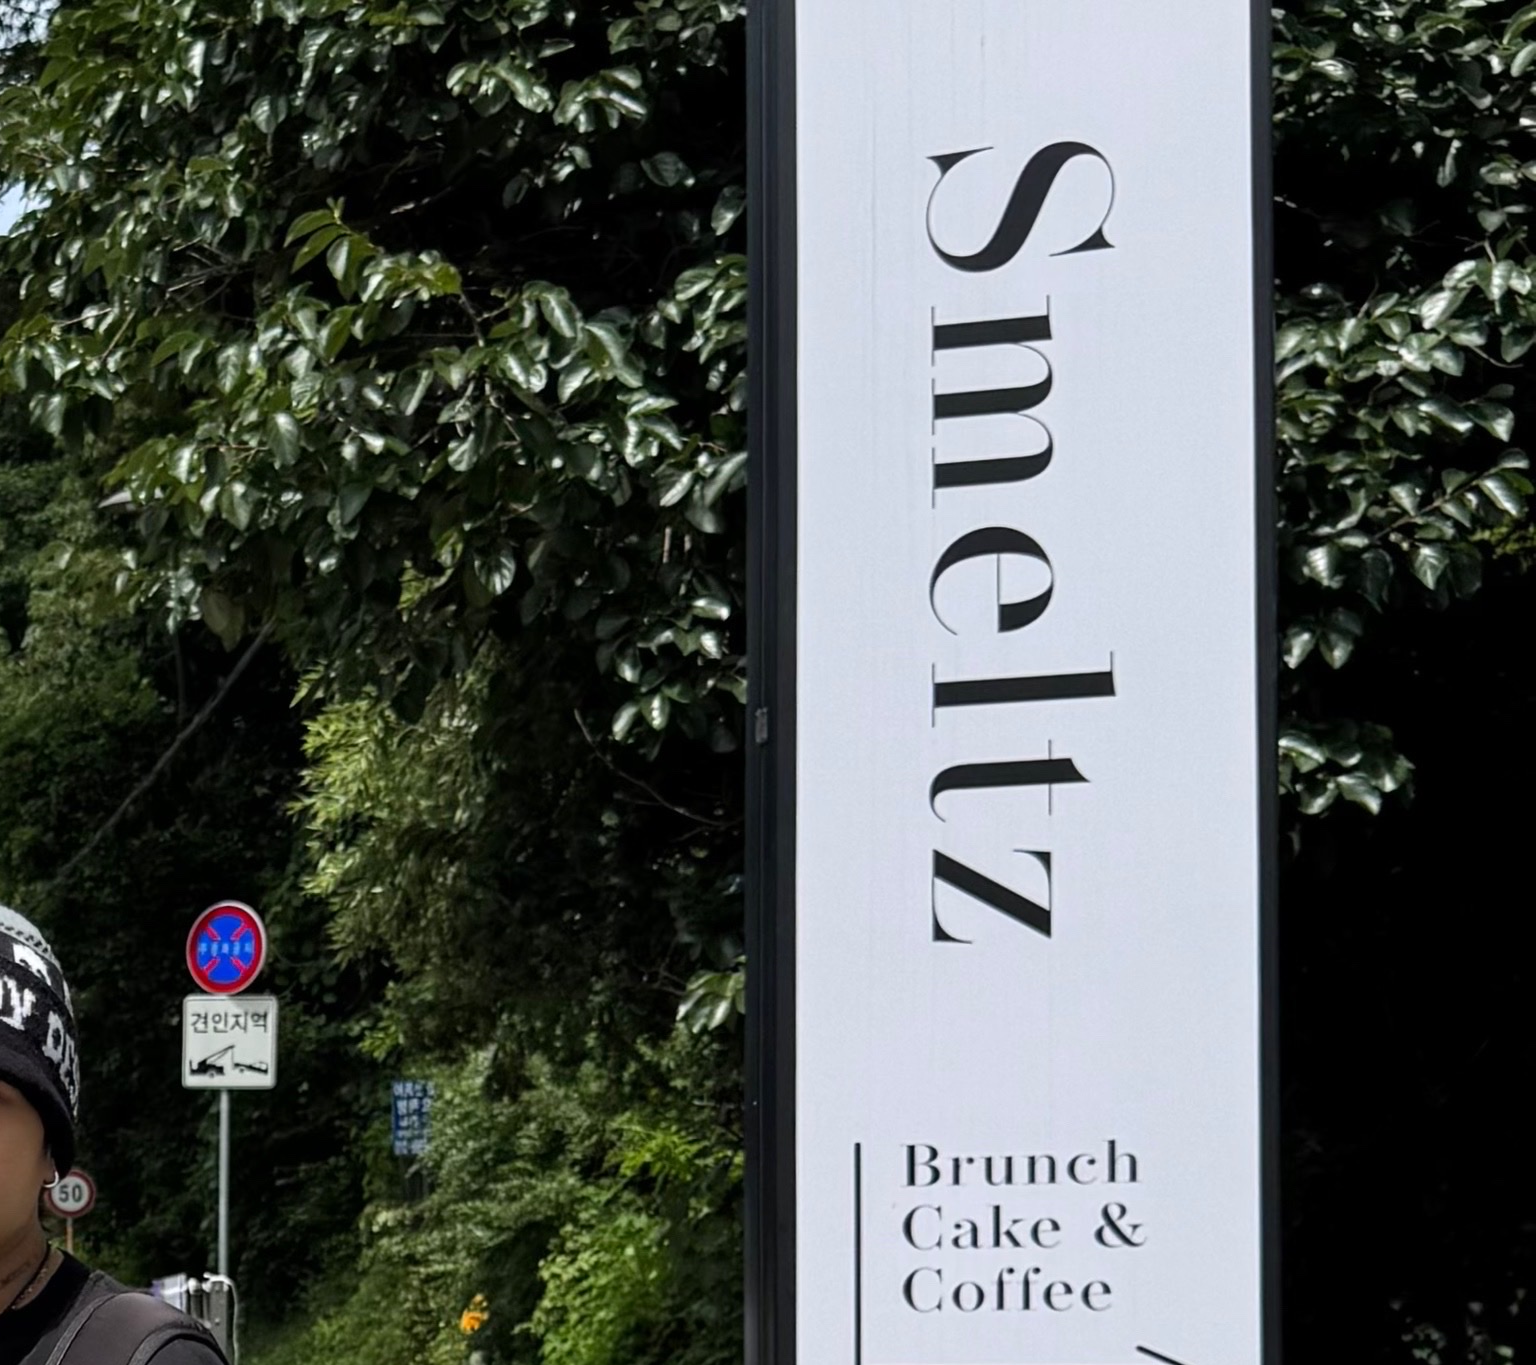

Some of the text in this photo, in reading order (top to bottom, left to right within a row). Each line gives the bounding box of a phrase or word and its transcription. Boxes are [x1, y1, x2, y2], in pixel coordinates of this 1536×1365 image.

[926, 140, 1115, 944] Smeltz
[191, 1011, 268, 1034] 견인지역
[900, 1139, 1142, 1188] Brunch
[58, 1184, 83, 1203] 50
[901, 1202, 1147, 1250] Cake &
[901, 1266, 1112, 1312] Coffee
